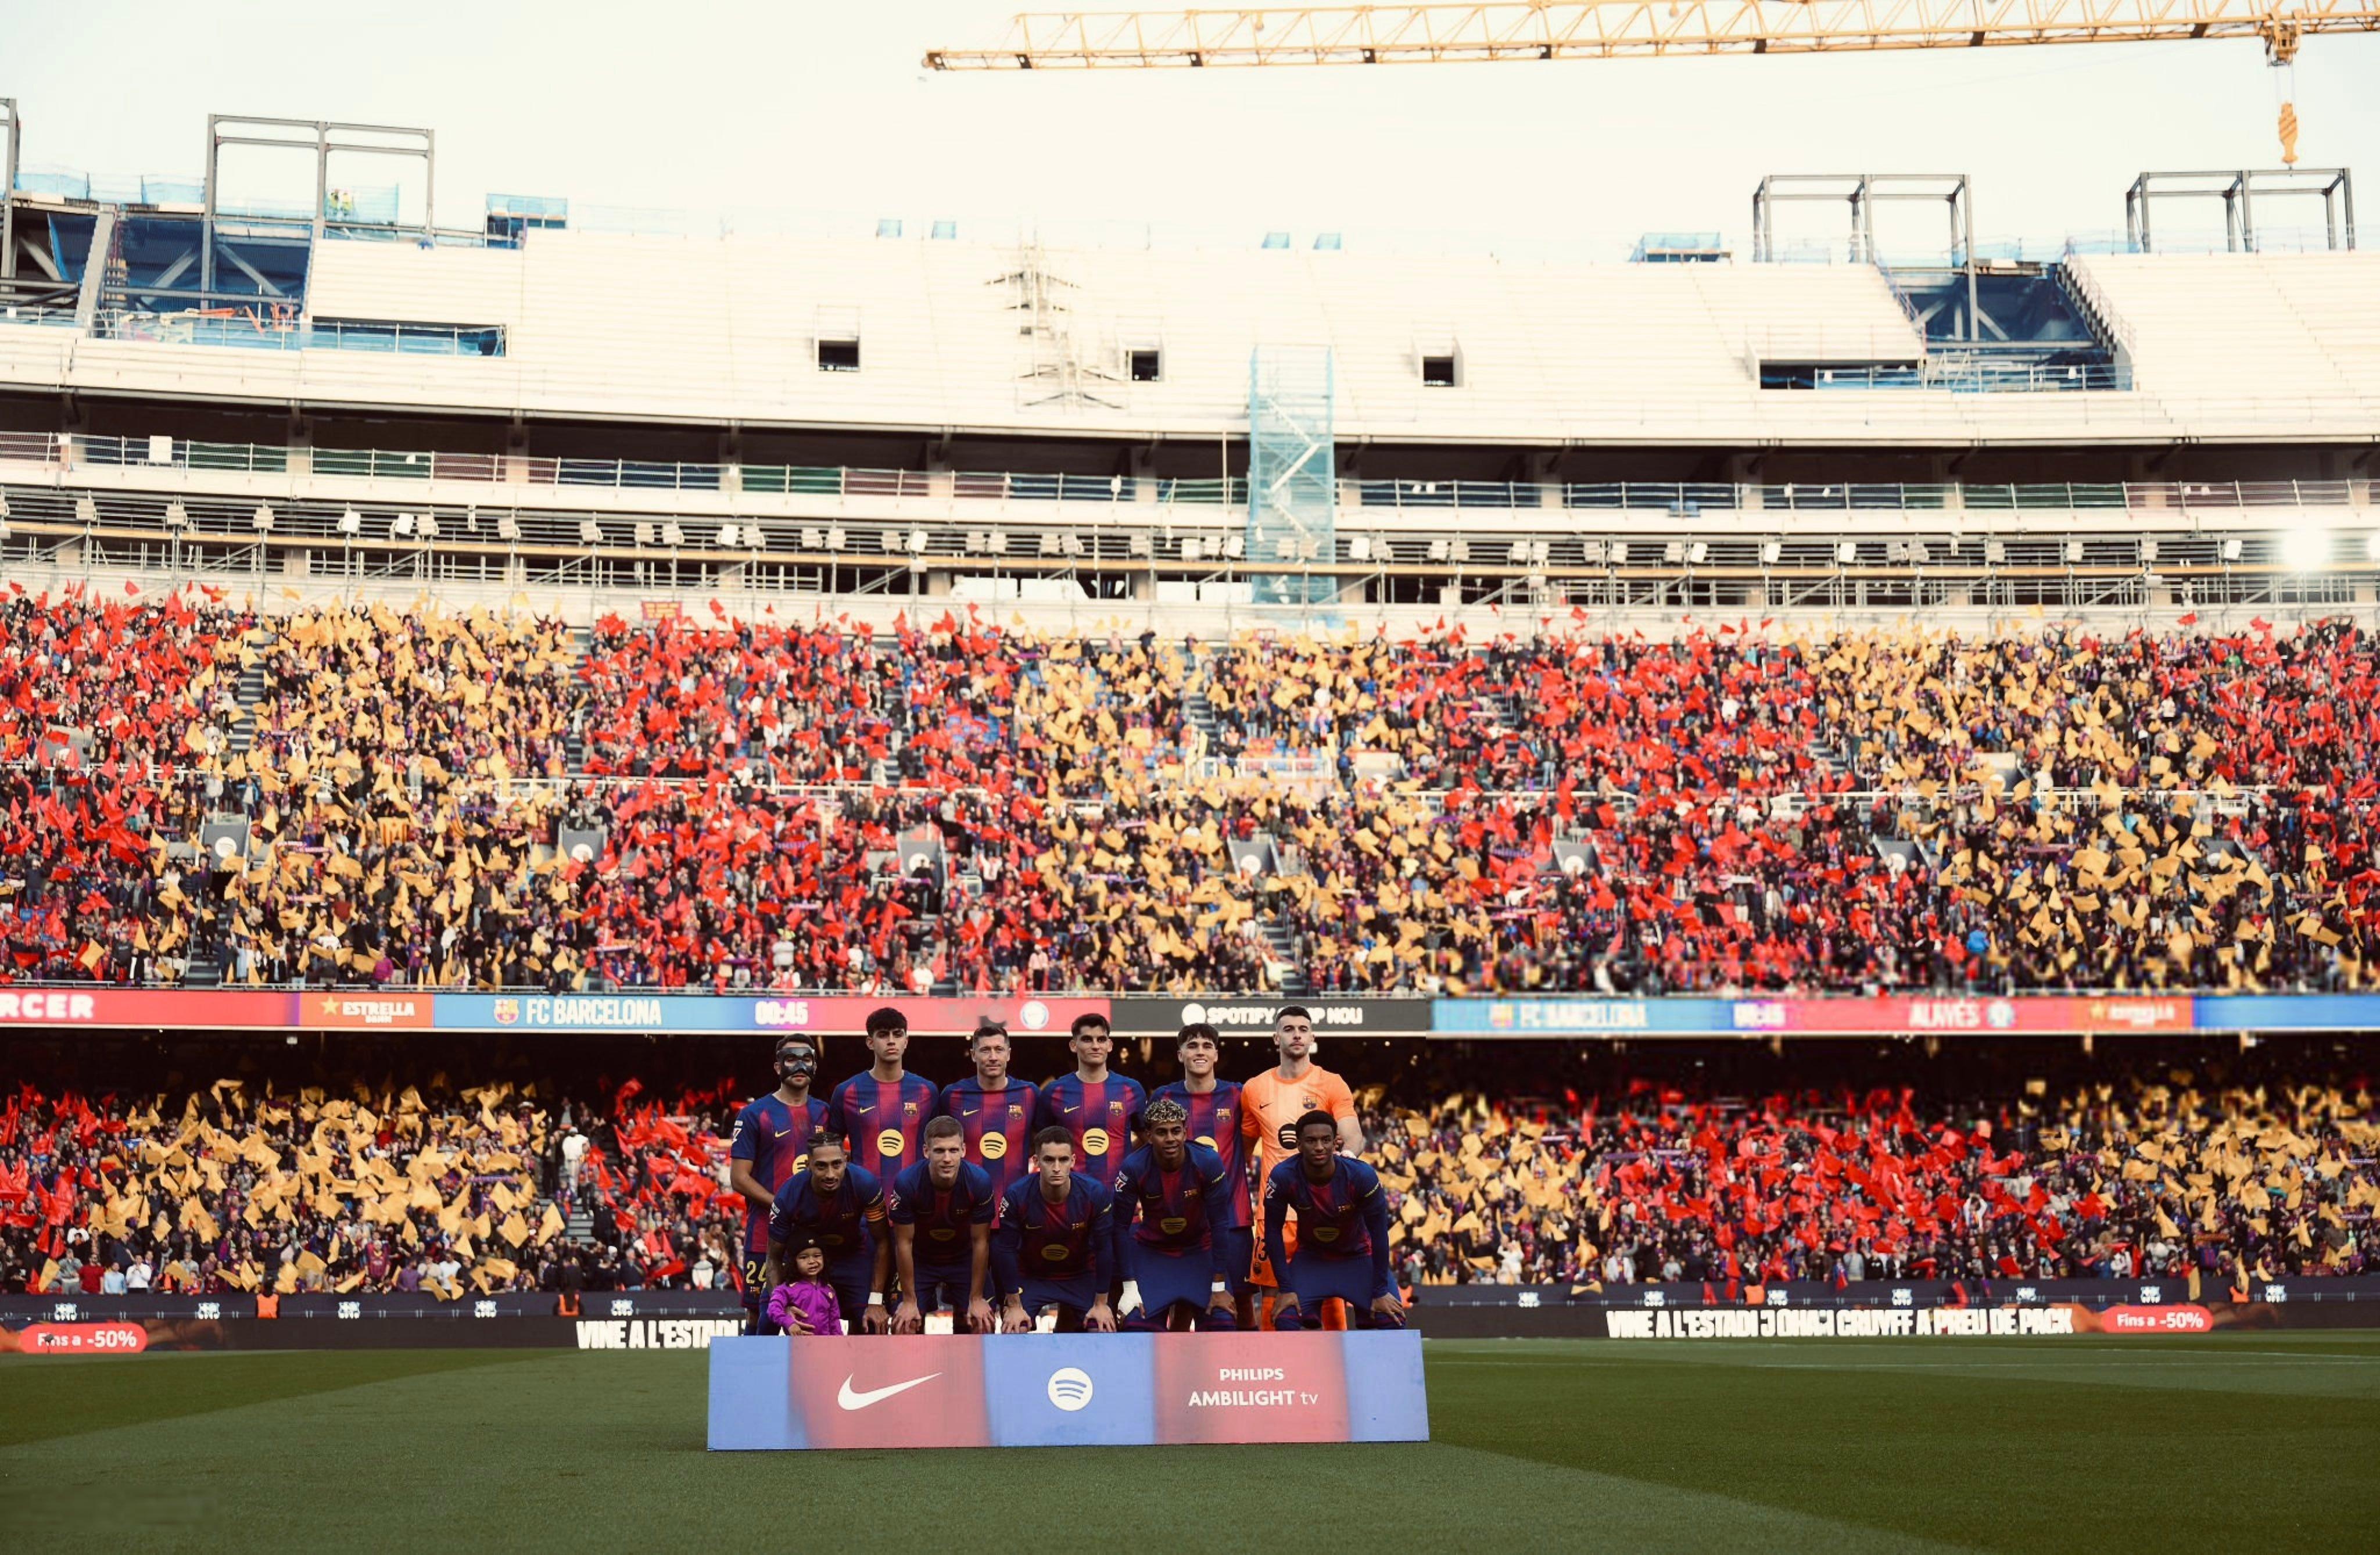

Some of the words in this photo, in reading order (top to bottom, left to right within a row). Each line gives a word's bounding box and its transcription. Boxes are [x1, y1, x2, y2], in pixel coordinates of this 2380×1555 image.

[342, 1001, 415, 1016] ESTRELLA
[526, 998, 550, 1024] FC
[554, 999, 662, 1025] BARCELONA
[755, 1001, 808, 1024] 00:45
[1207, 1008, 1275, 1024] SPOTIFY
[1656, 1310, 1671, 1337] A
[1673, 1310, 1758, 1338] L'ESTADI
[1916, 1310, 1931, 1335] A
[1934, 1309, 1988, 1335] PREU
[1989, 1308, 2017, 1335] DE
[2019, 1308, 2074, 1334] PACK
[2117, 1313, 2145, 1327] Fins
[2147, 1316, 2156, 1327] a
[2159, 1312, 2205, 1328] -50%
[71, 1335, 81, 1346] a
[87, 1330, 137, 1348] -50%
[576, 1320, 626, 1349] VINE
[629, 1320, 645, 1348] A
[1220, 1368, 1284, 1381] PHILIPS
[1189, 1390, 1295, 1406] AMBILIGHT
[1300, 1391, 1318, 1404] tv
